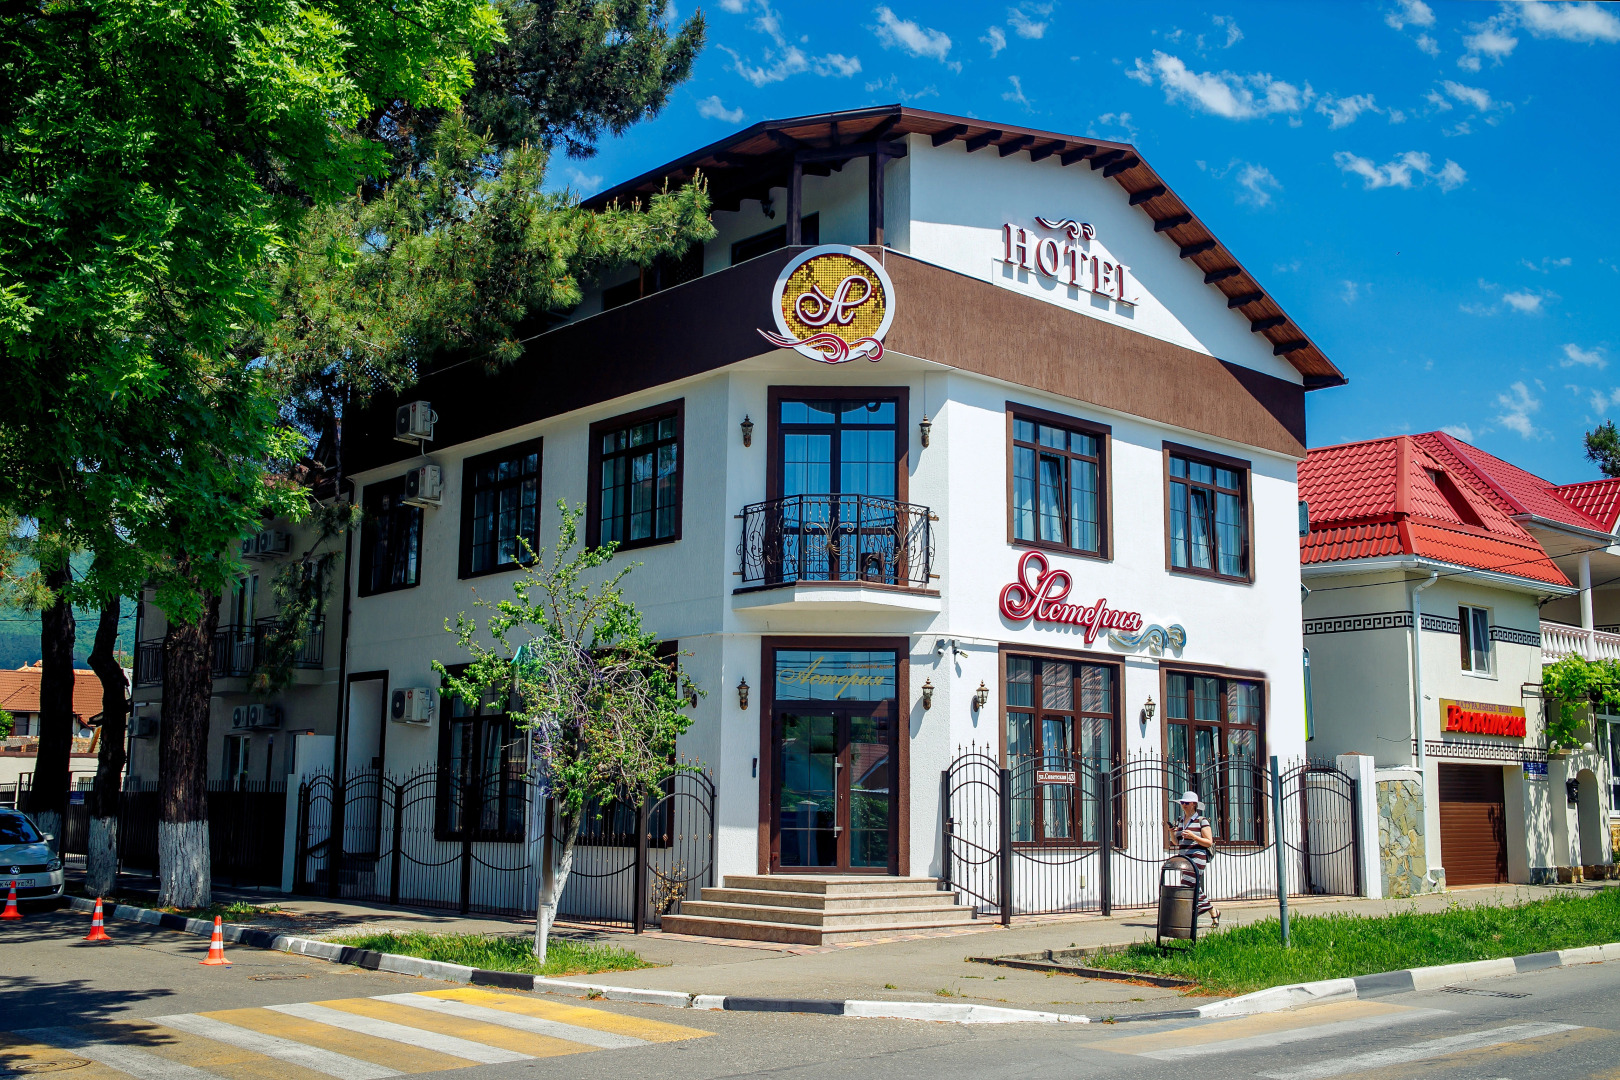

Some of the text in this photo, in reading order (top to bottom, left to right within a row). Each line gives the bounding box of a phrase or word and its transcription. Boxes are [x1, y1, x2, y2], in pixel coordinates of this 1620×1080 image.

[1003, 222, 1139, 306] HOTEL
[777, 656, 885, 698] Астерия
[1446, 705, 1527, 736] Винотека
